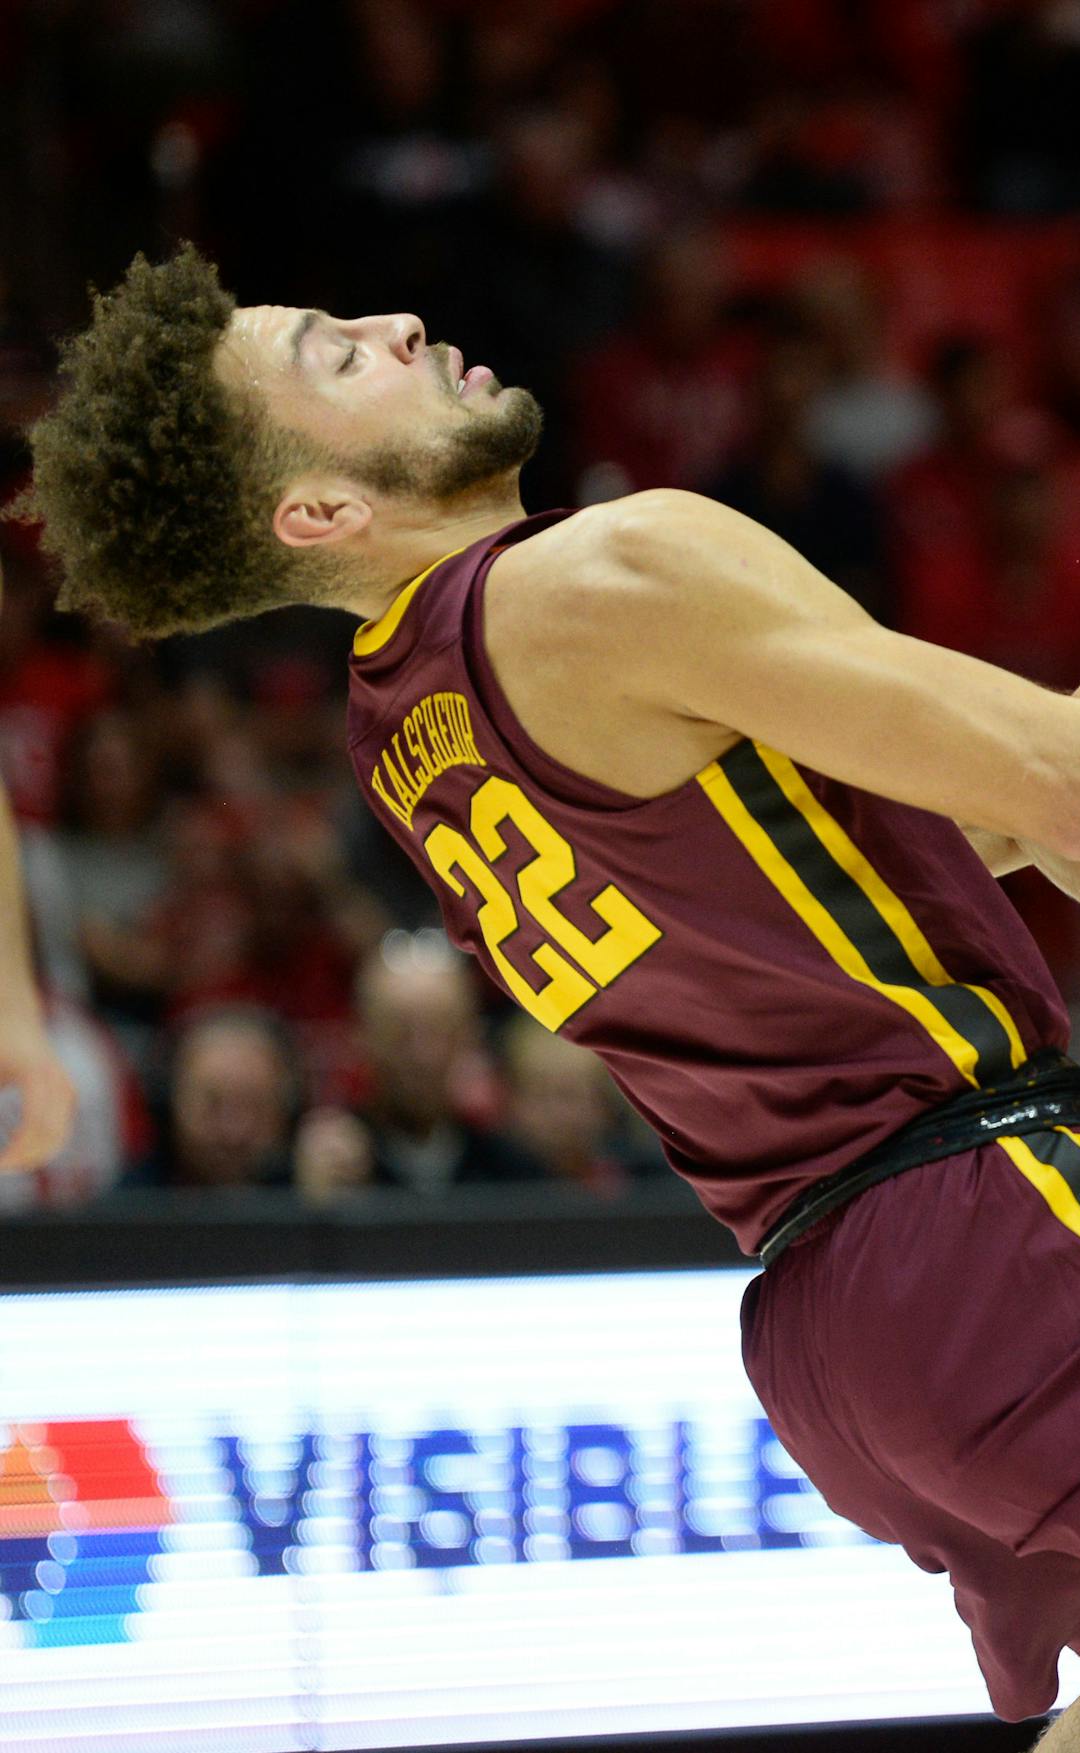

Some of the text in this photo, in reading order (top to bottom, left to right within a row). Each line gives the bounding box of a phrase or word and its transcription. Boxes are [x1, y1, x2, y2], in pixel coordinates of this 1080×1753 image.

[372, 692, 487, 832] KALSCHEUR
[423, 775, 664, 1034] 22
[209, 1418, 810, 1577] VISIBLE
